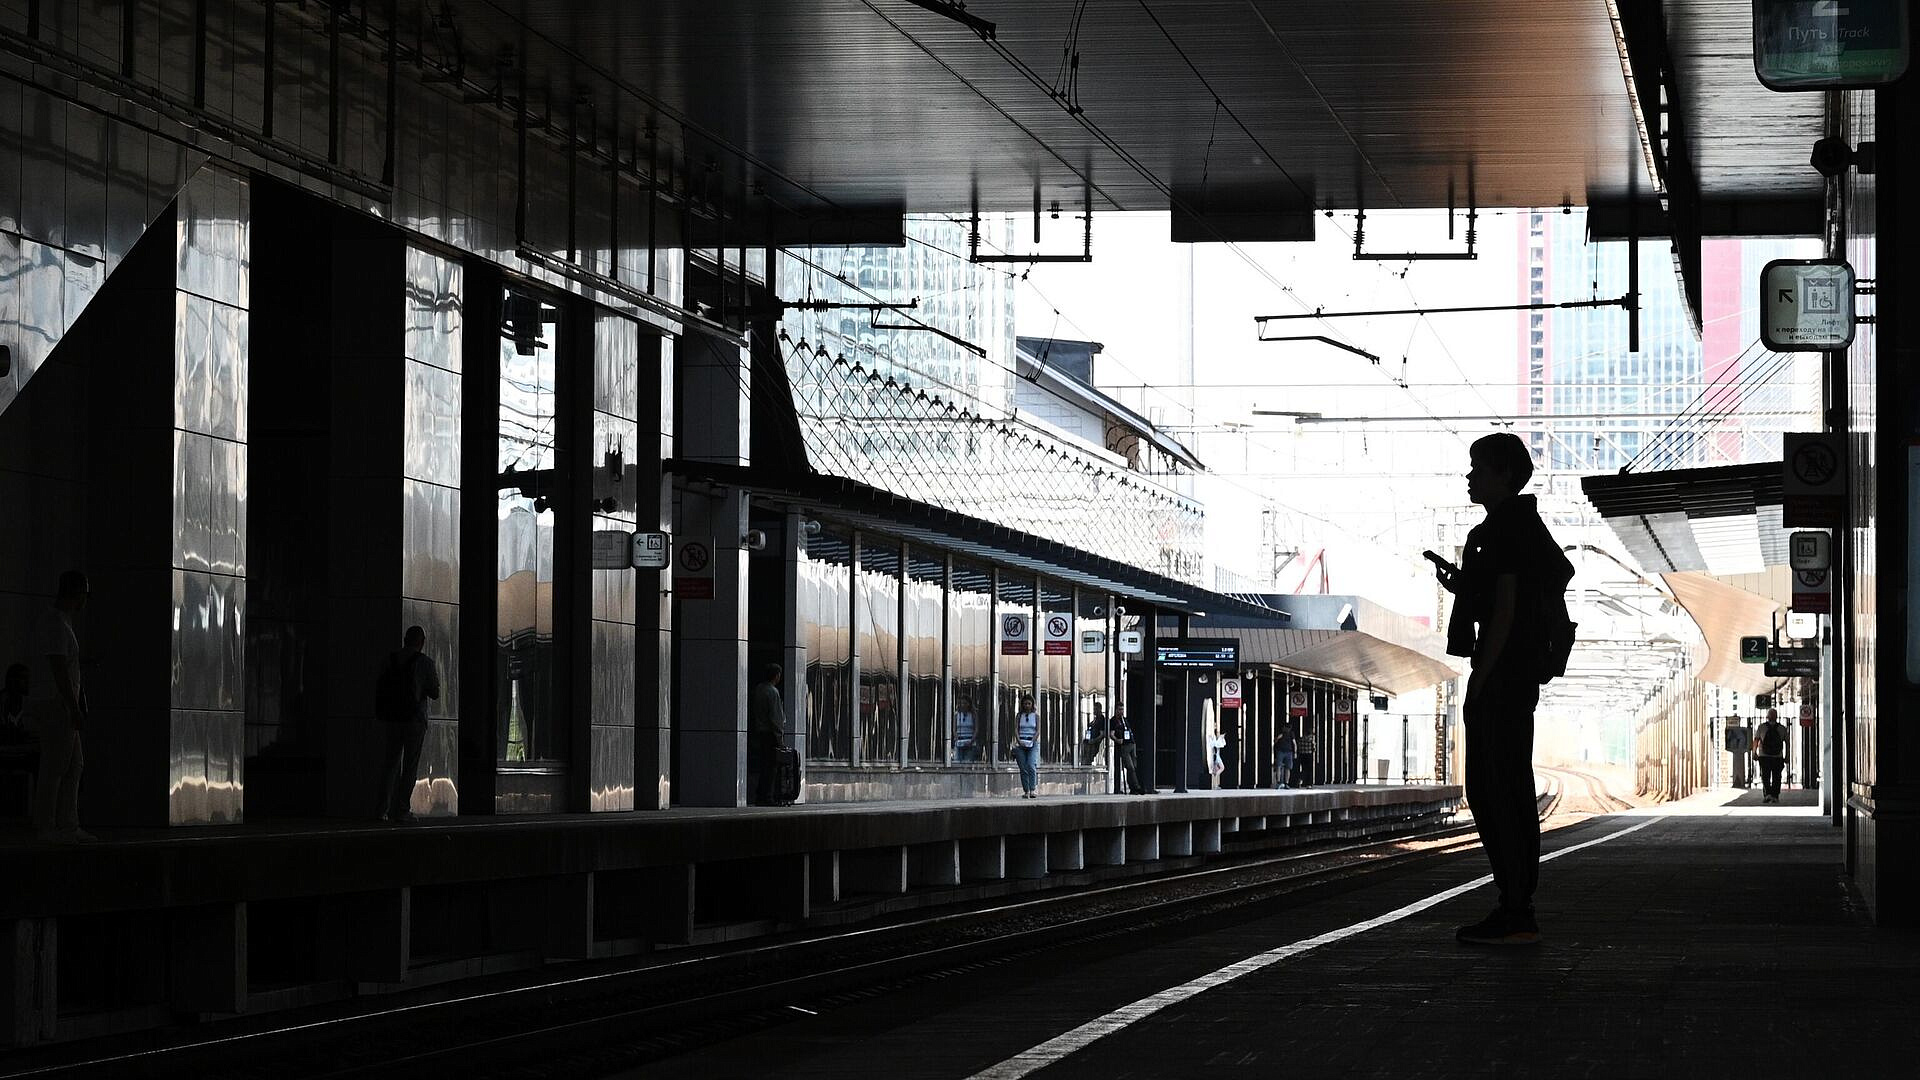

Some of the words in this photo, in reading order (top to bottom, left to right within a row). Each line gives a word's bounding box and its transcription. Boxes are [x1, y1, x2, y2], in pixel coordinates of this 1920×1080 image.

[1789, 27, 1827, 43] Путь
[1839, 25, 1870, 38] Track
[1750, 639, 1758, 652] 2
